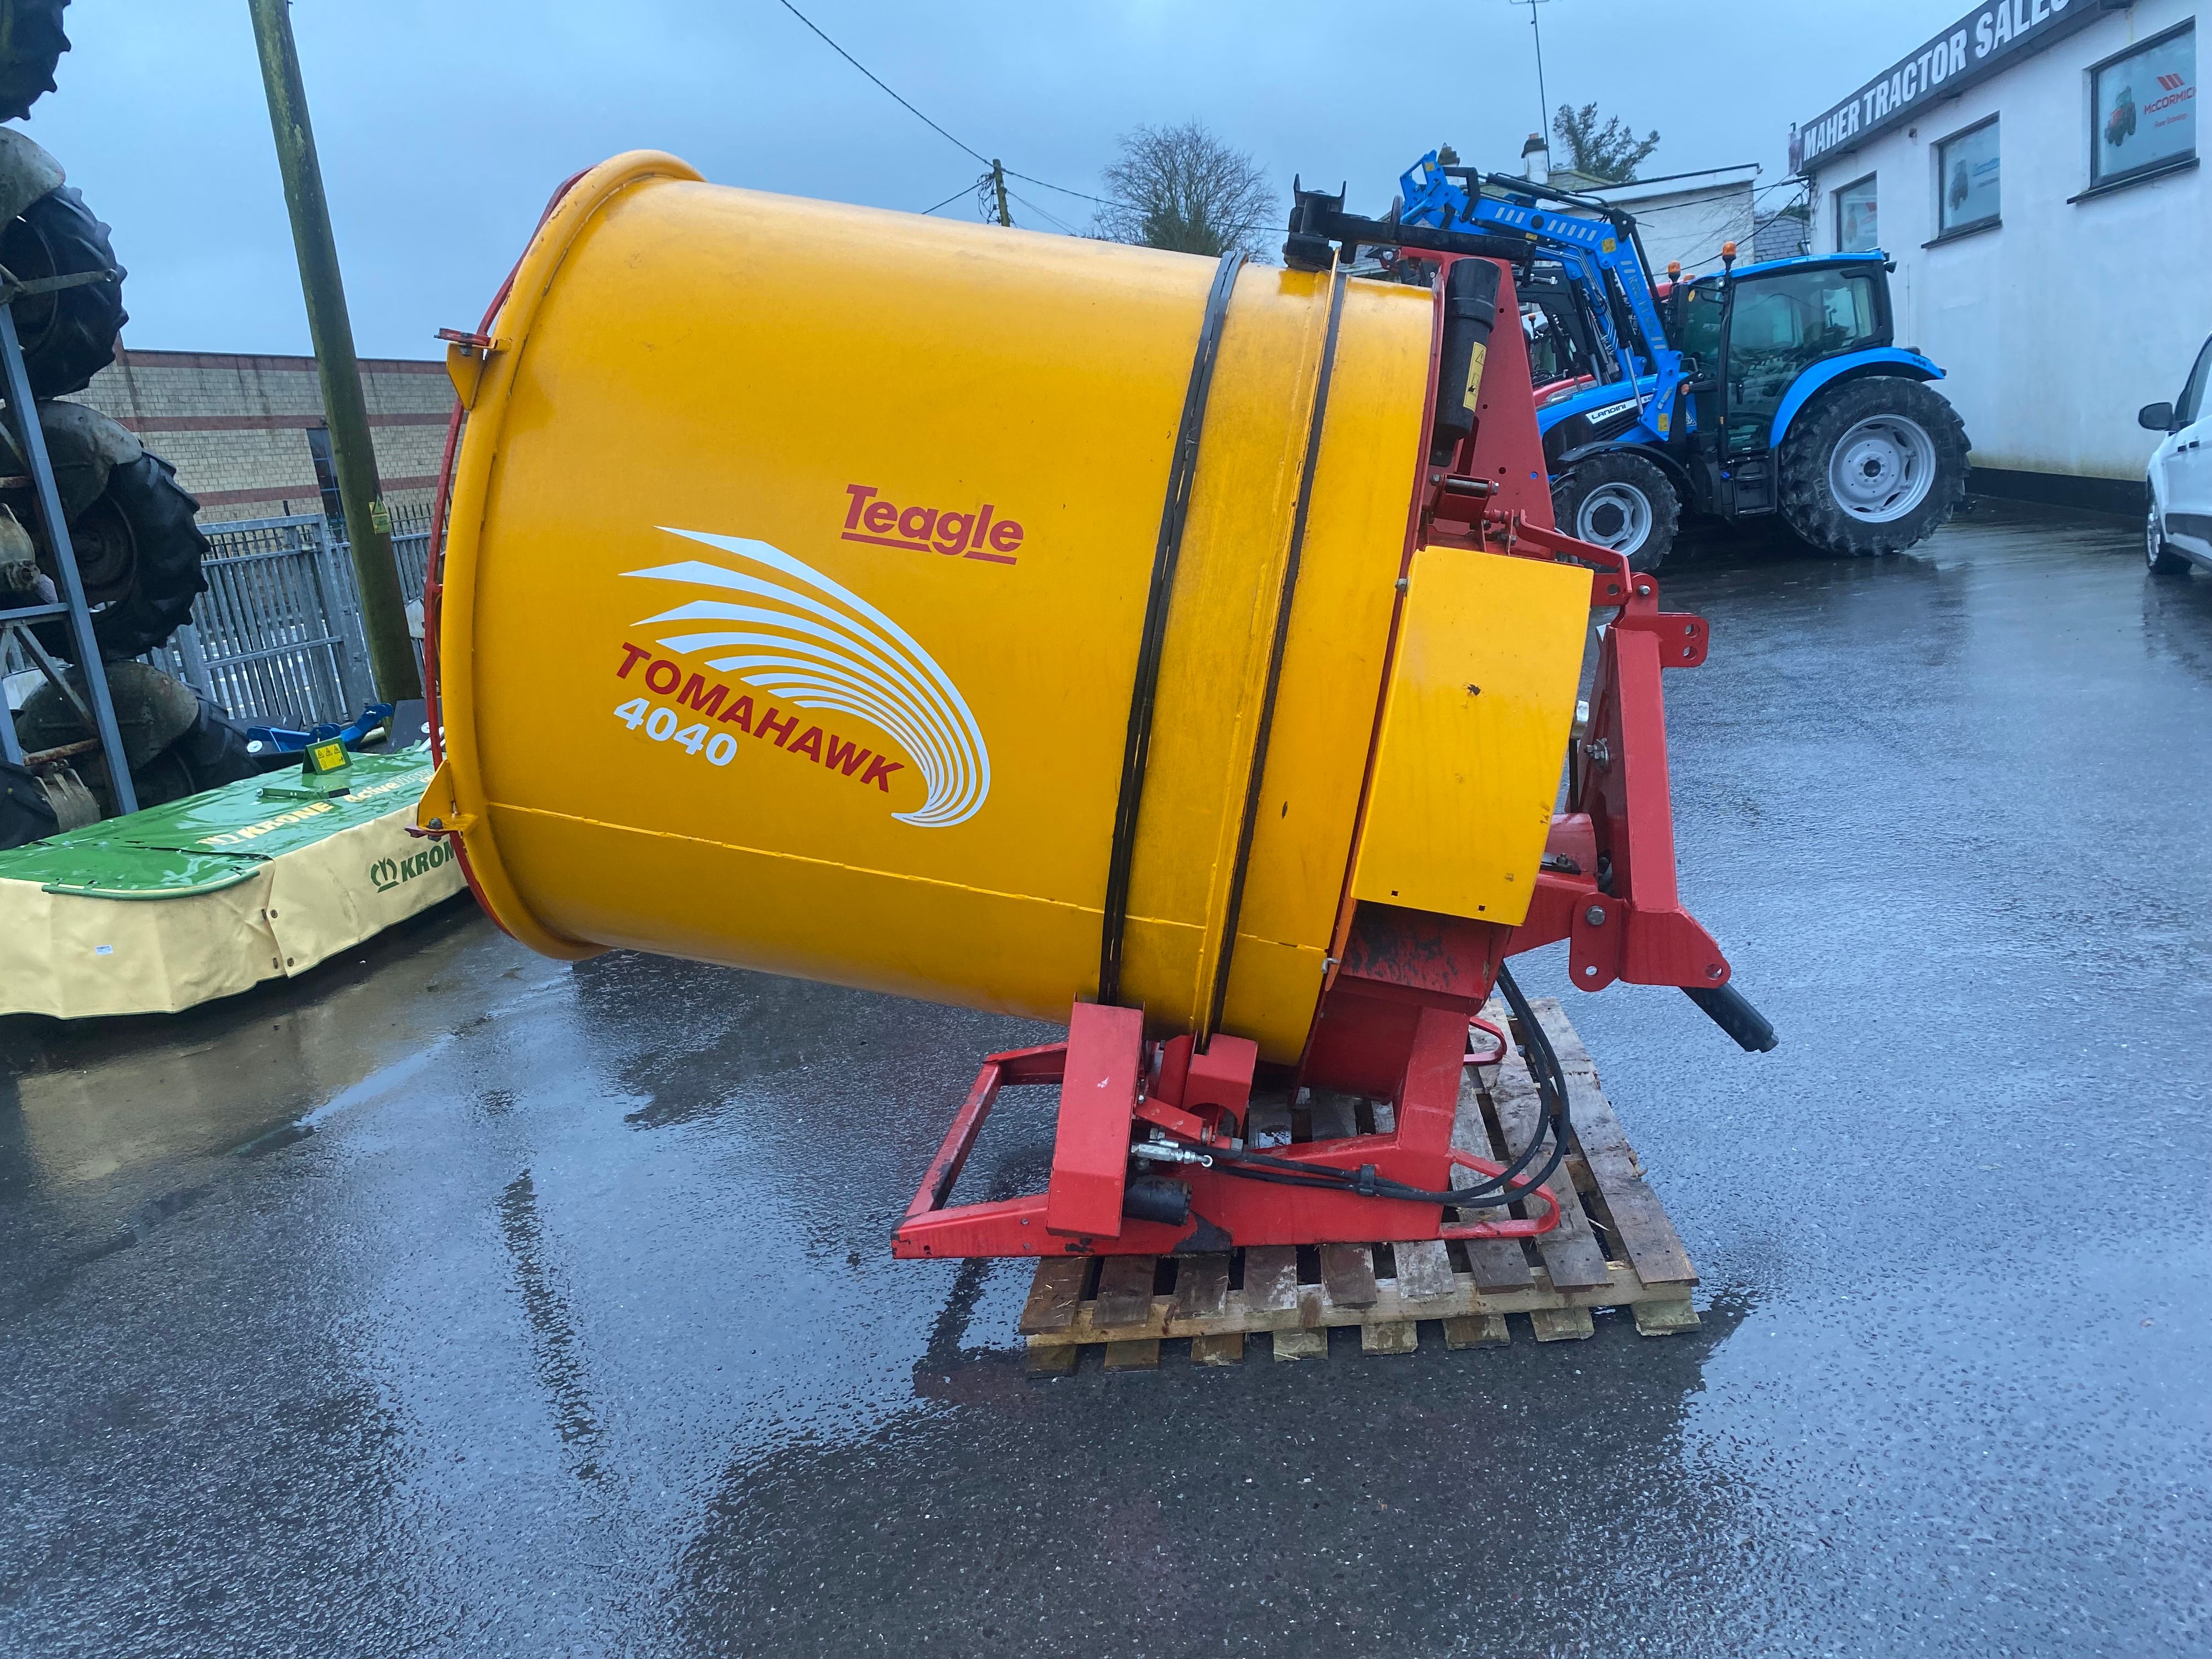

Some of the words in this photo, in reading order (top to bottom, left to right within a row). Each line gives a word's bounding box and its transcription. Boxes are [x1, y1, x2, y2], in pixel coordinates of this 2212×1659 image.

[1803, 99, 1860, 162] MAHER
[1863, 32, 1968, 126] TRACTOR
[1592, 404, 1627, 419] LANDINI
[843, 484, 1024, 556] Teagle
[613, 698, 738, 766] 4040
[616, 642, 905, 794] TOMAHAWK
[236, 801, 334, 839] KRONE
